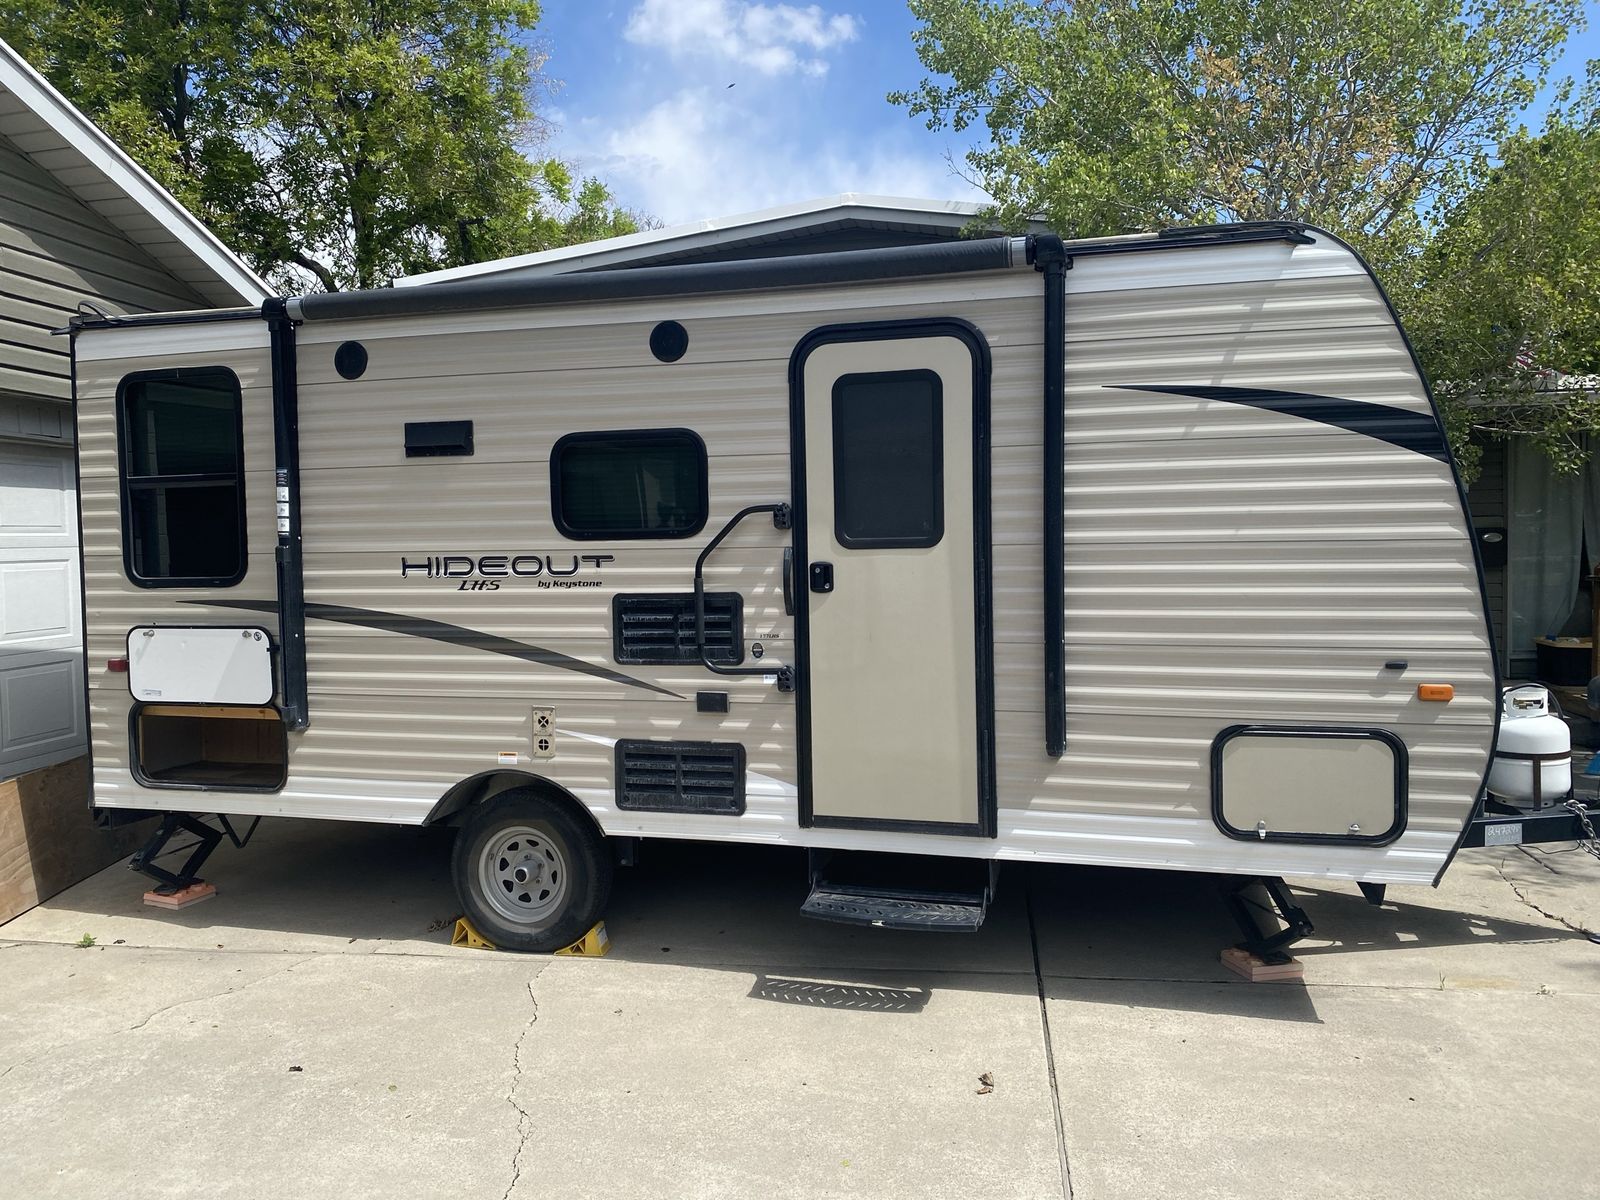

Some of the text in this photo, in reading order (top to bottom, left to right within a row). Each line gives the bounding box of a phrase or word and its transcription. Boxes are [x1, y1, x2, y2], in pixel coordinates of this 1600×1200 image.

[401, 554, 615, 578] HIDEOUT
[537, 579, 602, 589] by Keystone
